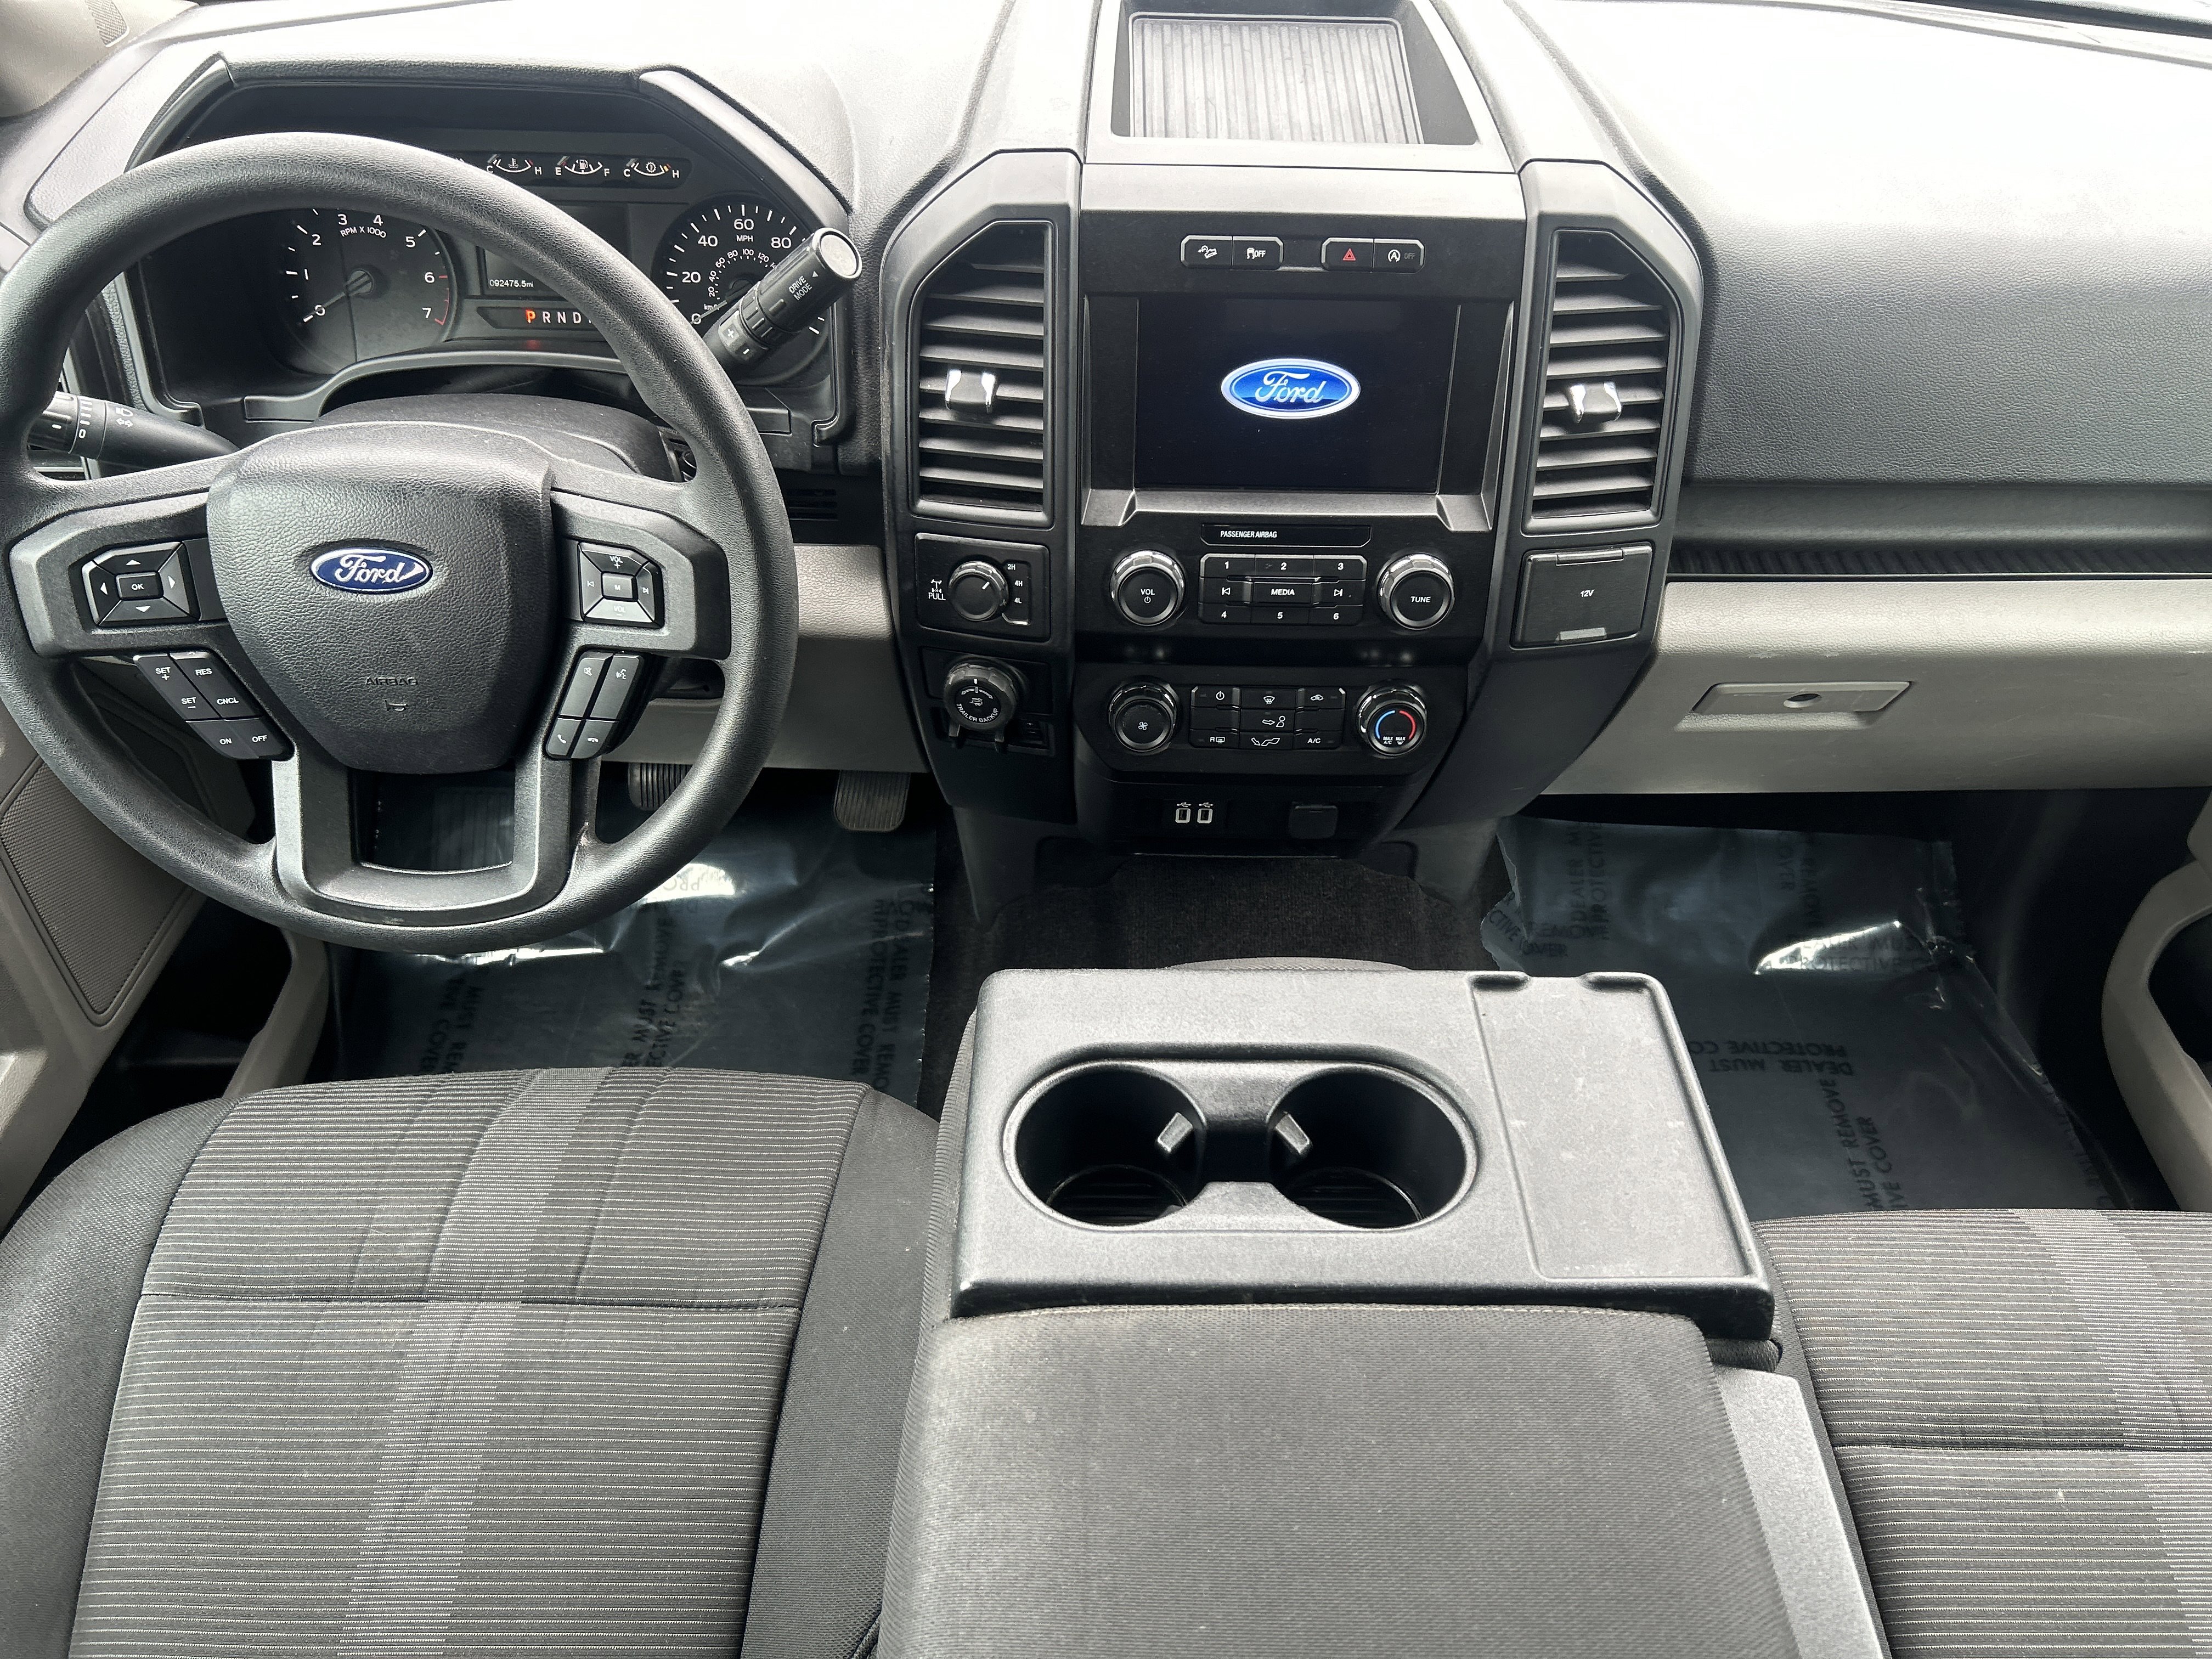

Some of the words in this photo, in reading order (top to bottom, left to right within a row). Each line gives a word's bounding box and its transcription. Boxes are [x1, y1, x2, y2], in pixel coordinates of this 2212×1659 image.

[534, 167, 542, 175] H
[555, 167, 562, 176] E
[604, 168, 610, 177] F
[623, 168, 631, 177] C
[672, 170, 680, 178] H
[337, 214, 347, 225] 3
[373, 215, 383, 226] 4
[733, 219, 754, 230] 60
[340, 227, 357, 237] RPM
[367, 227, 386, 238] 1000
[312, 234, 321, 245] 2
[405, 237, 415, 247] 5
[698, 235, 718, 247] 40
[771, 237, 792, 249] 80
[727, 250, 738, 259] 80
[758, 252, 769, 262] 120
[1254, 250, 1266, 258] OFF
[715, 257, 725, 268] 60
[425, 272, 435, 283] 6
[682, 272, 701, 283] 20
[709, 270, 716, 282] 40
[788, 275, 806, 293] DRIVE
[708, 286, 715, 297] 20
[793, 284, 812, 301] MODE
[422, 308, 431, 318] 7
[526, 309, 536, 324] P
[543, 312, 551, 324] R
[557, 312, 567, 324] N
[573, 312, 582, 324] D
[1255, 371, 1327, 403] Ford
[610, 555, 623, 563] VOL
[334, 554, 425, 584] Ford
[1280, 562, 1287, 571] 2
[1338, 562, 1344, 571] 3
[928, 592, 946, 601] PULL
[1580, 589, 1594, 597] 12V
[365, 676, 418, 686] AIRBAG
[217, 697, 239, 705] CNCL
[956, 703, 978, 723] TRAILER
[978, 708, 999, 723] BACKUP
[219, 737, 232, 746] ON
[851, 1024, 877, 1076] COVER
[1722, 1040, 1848, 1058] PROTECTIVE
[1708, 1058, 1765, 1073] MUST
[1778, 1059, 1853, 1076] DEALER
[1819, 1077, 1859, 1149] REMOVE
[1855, 1115, 1894, 1175] COVER
[1845, 1158, 1884, 1210] MUST
